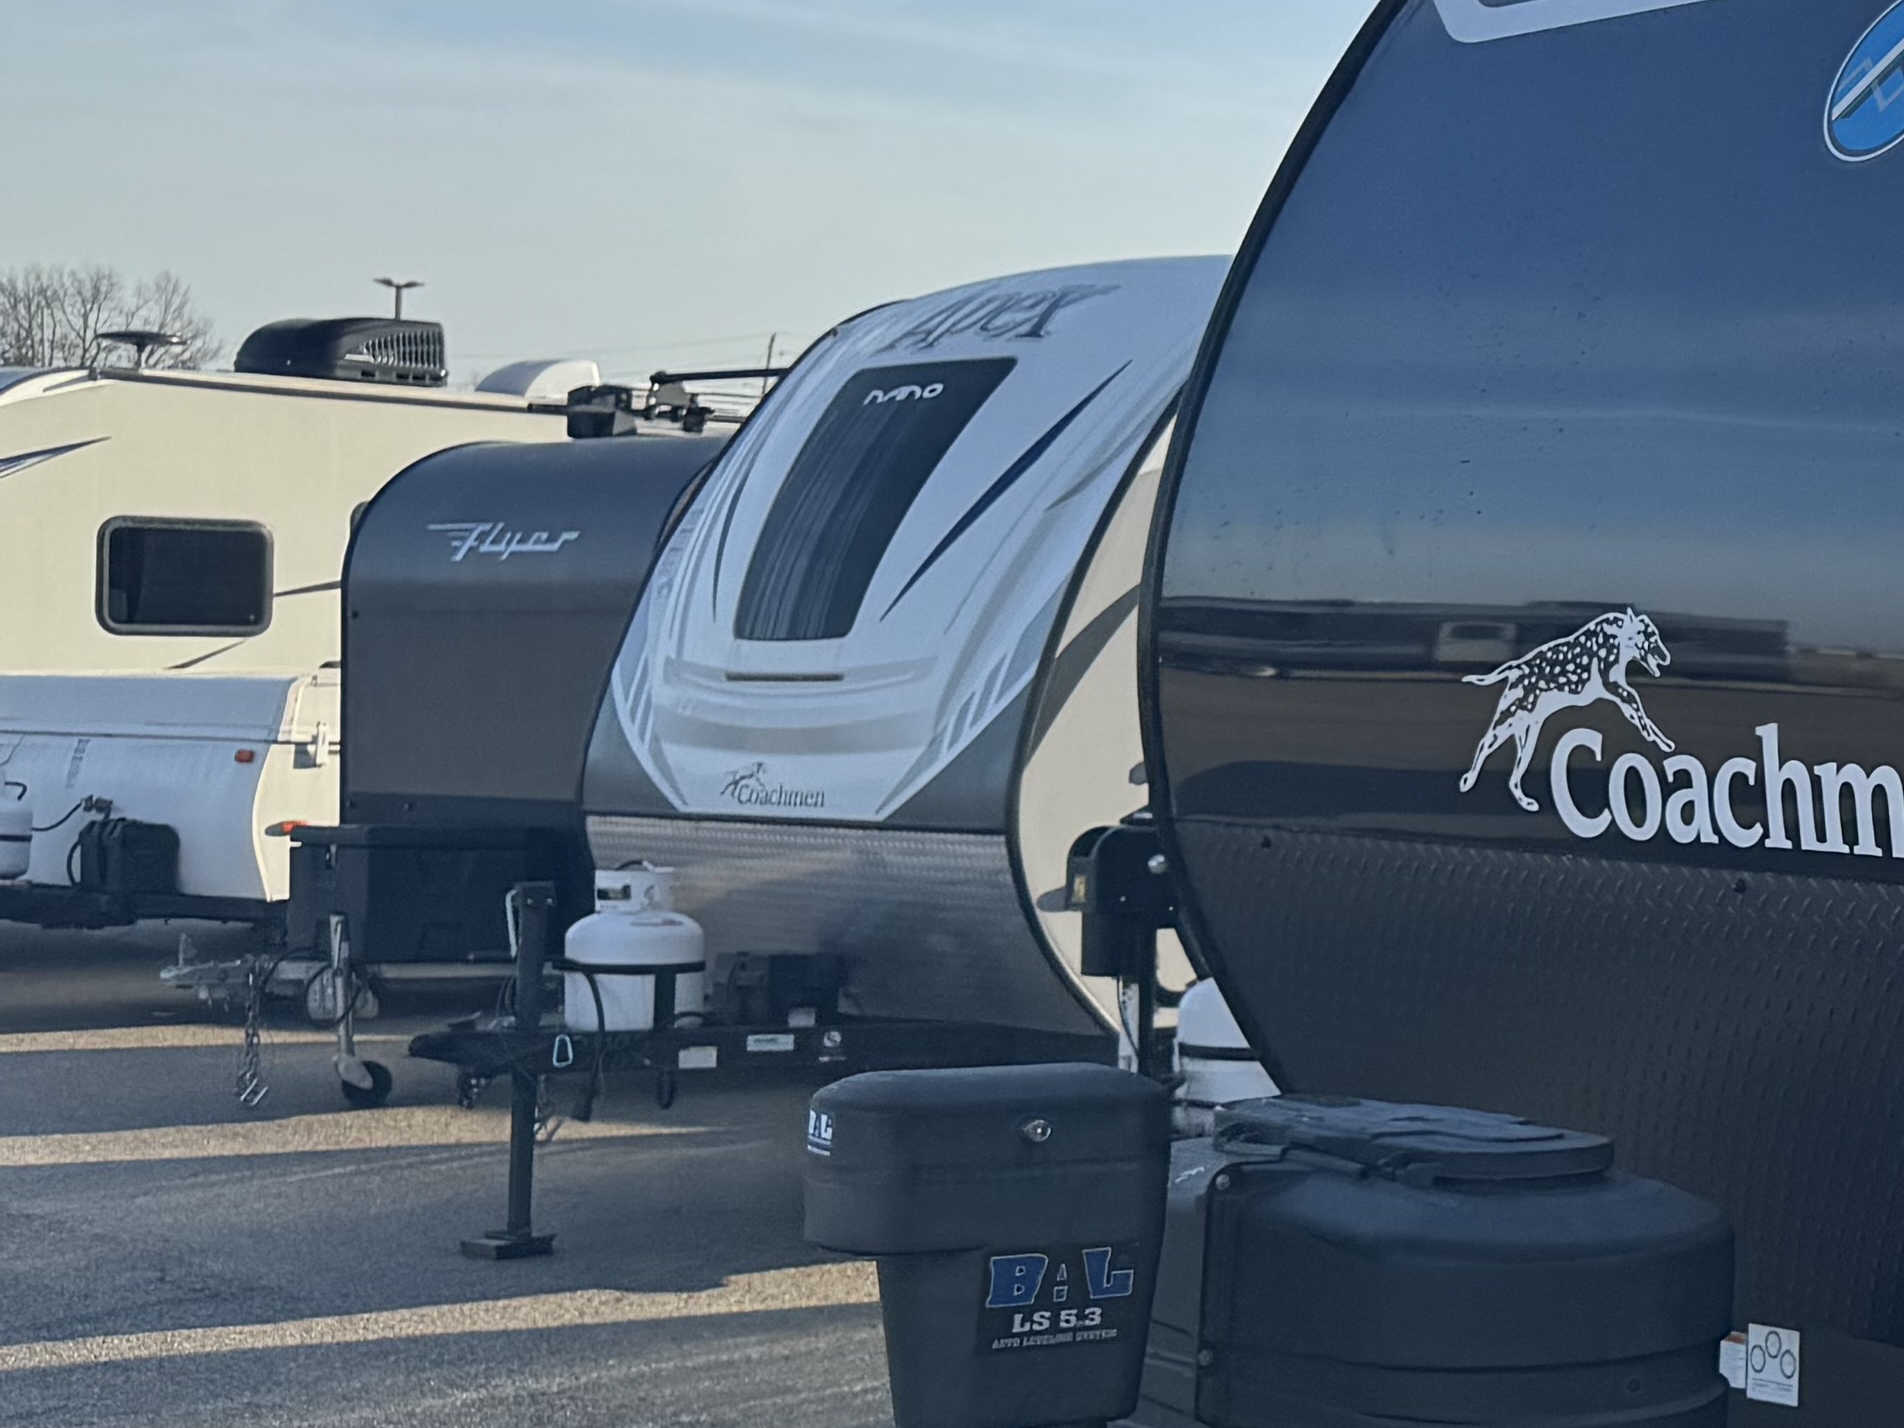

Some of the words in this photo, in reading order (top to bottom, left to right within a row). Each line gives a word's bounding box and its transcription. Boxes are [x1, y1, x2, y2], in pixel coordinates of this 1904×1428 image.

[427, 522, 581, 561] Flyer
[737, 784, 825, 807] Coachmen
[1012, 1310, 1051, 1333] LS
